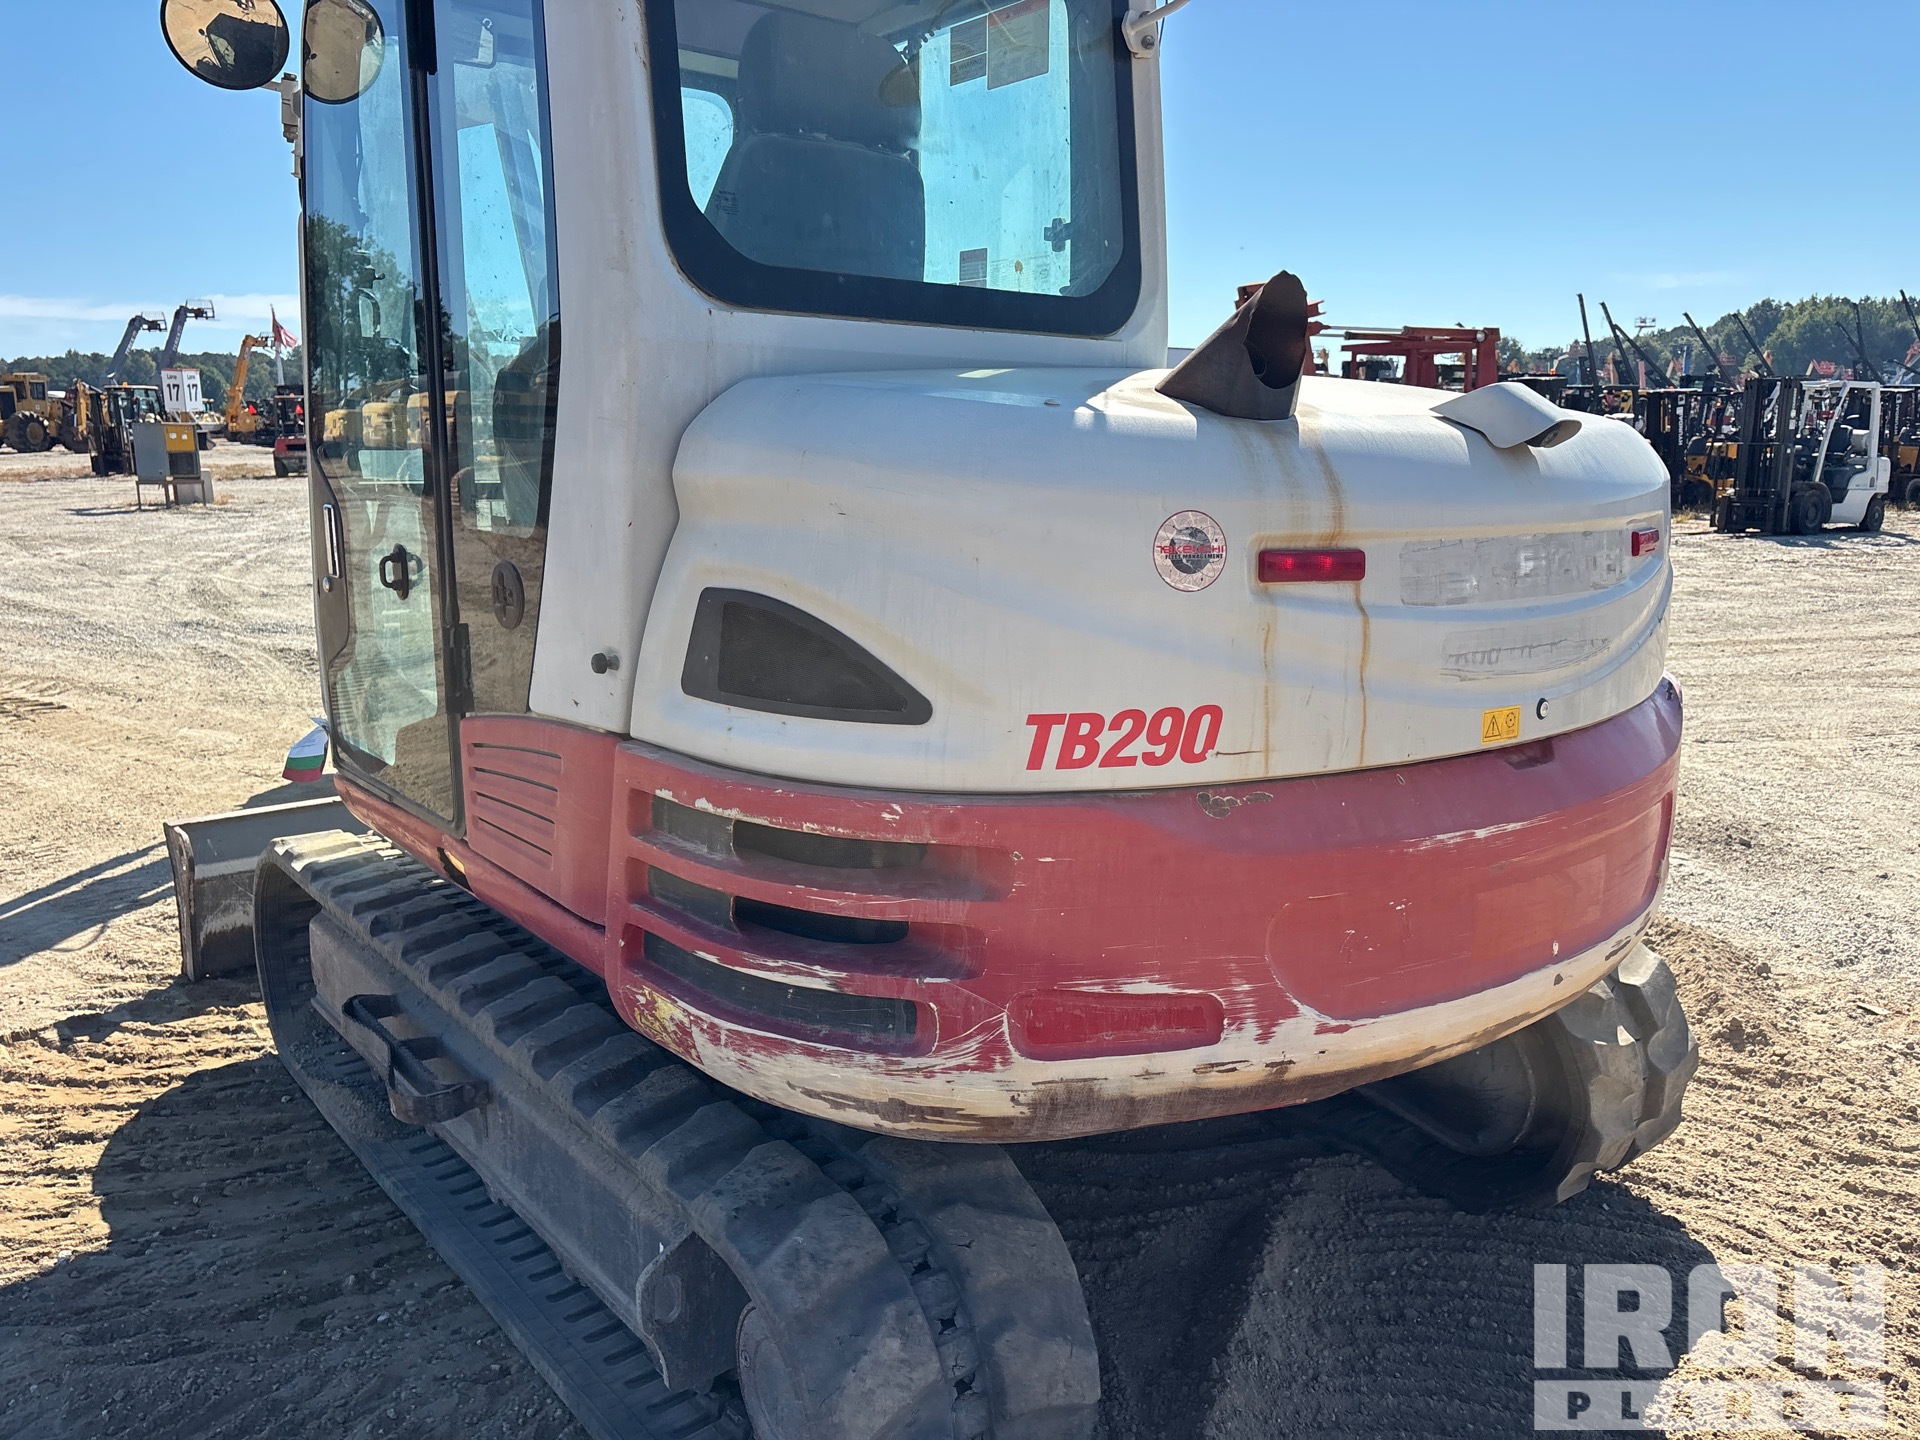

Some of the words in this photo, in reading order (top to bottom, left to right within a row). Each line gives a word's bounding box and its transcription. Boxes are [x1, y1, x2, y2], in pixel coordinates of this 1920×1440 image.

[167, 383, 180, 402] 17
[187, 383, 198, 402] 17
[1025, 704, 1224, 771] TB290
